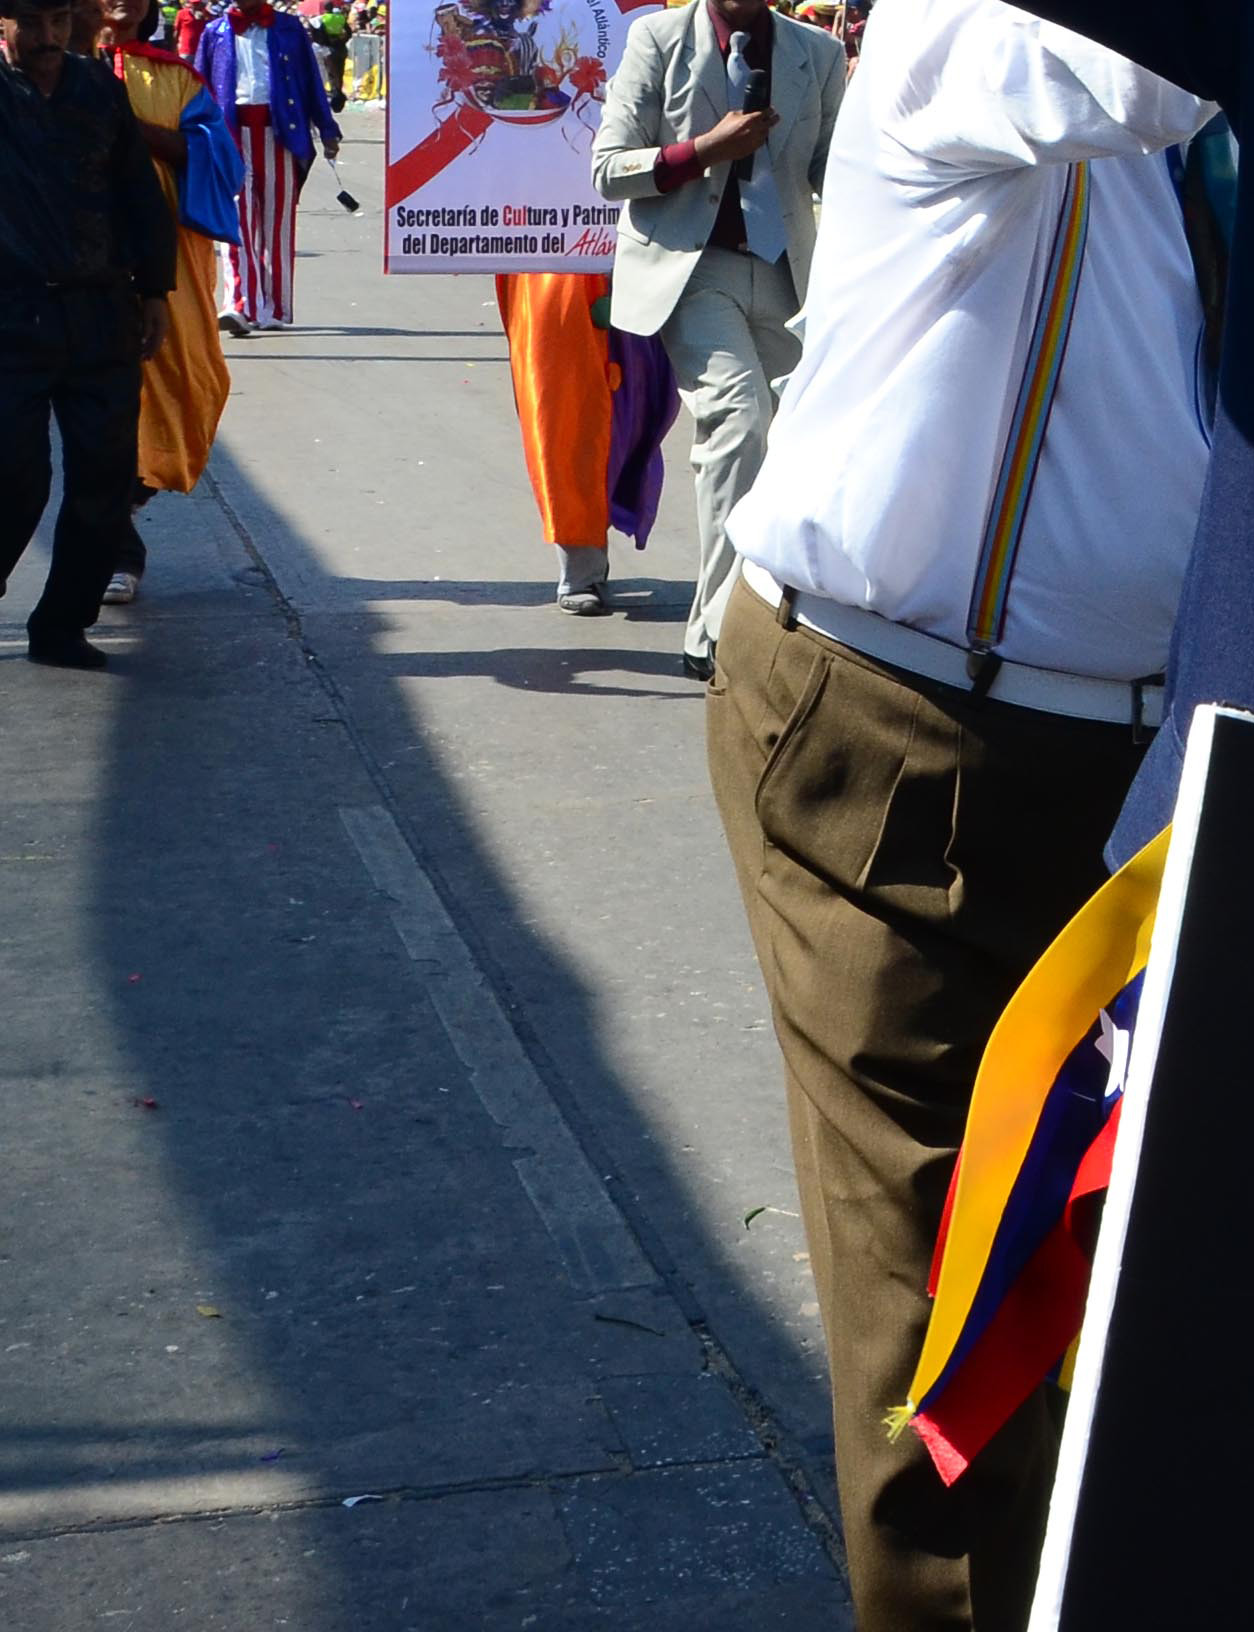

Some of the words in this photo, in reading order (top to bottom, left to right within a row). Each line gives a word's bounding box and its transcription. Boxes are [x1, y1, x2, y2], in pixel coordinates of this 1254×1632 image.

[592, 9, 610, 59] Atlántico
[397, 204, 476, 227] Secretaría
[481, 205, 499, 226] de
[503, 205, 558, 226] Cultura
[561, 208, 570, 228] y
[403, 234, 426, 254] del
[430, 234, 538, 256] Departamento
[542, 232, 565, 253] del
